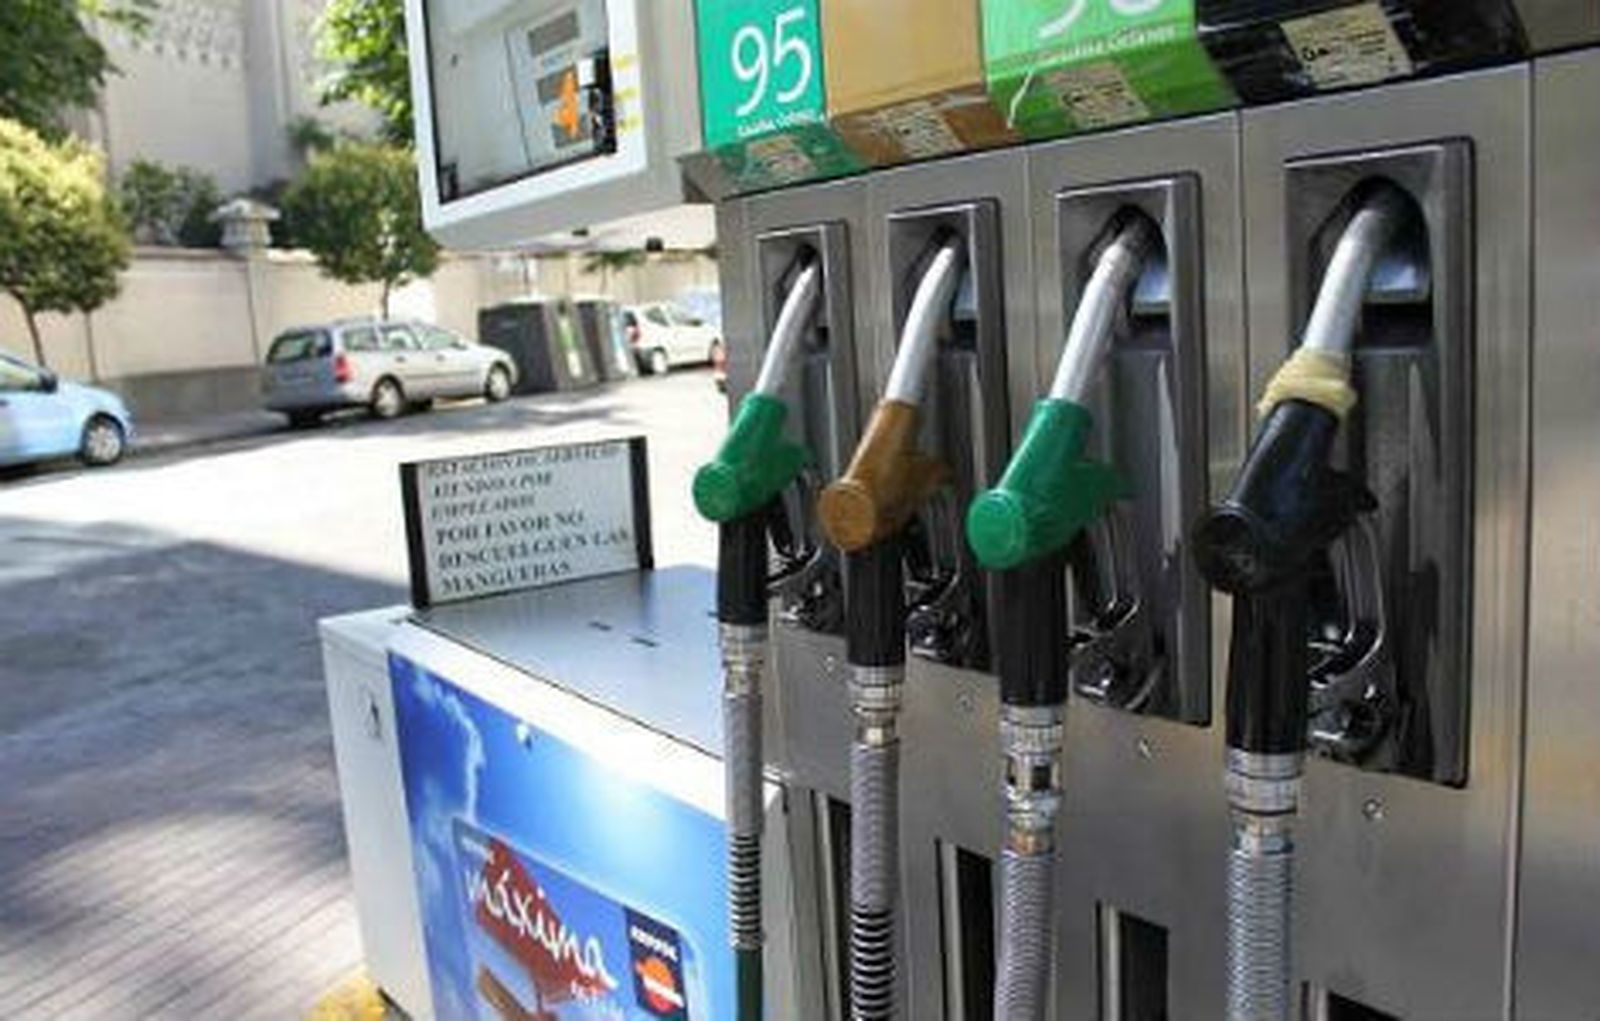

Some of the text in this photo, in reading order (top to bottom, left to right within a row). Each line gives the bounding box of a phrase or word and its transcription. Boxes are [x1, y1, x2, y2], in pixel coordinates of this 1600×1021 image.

[731, 7, 812, 116] 95
[436, 525, 480, 546] POR
[484, 514, 551, 540] FAVOR
